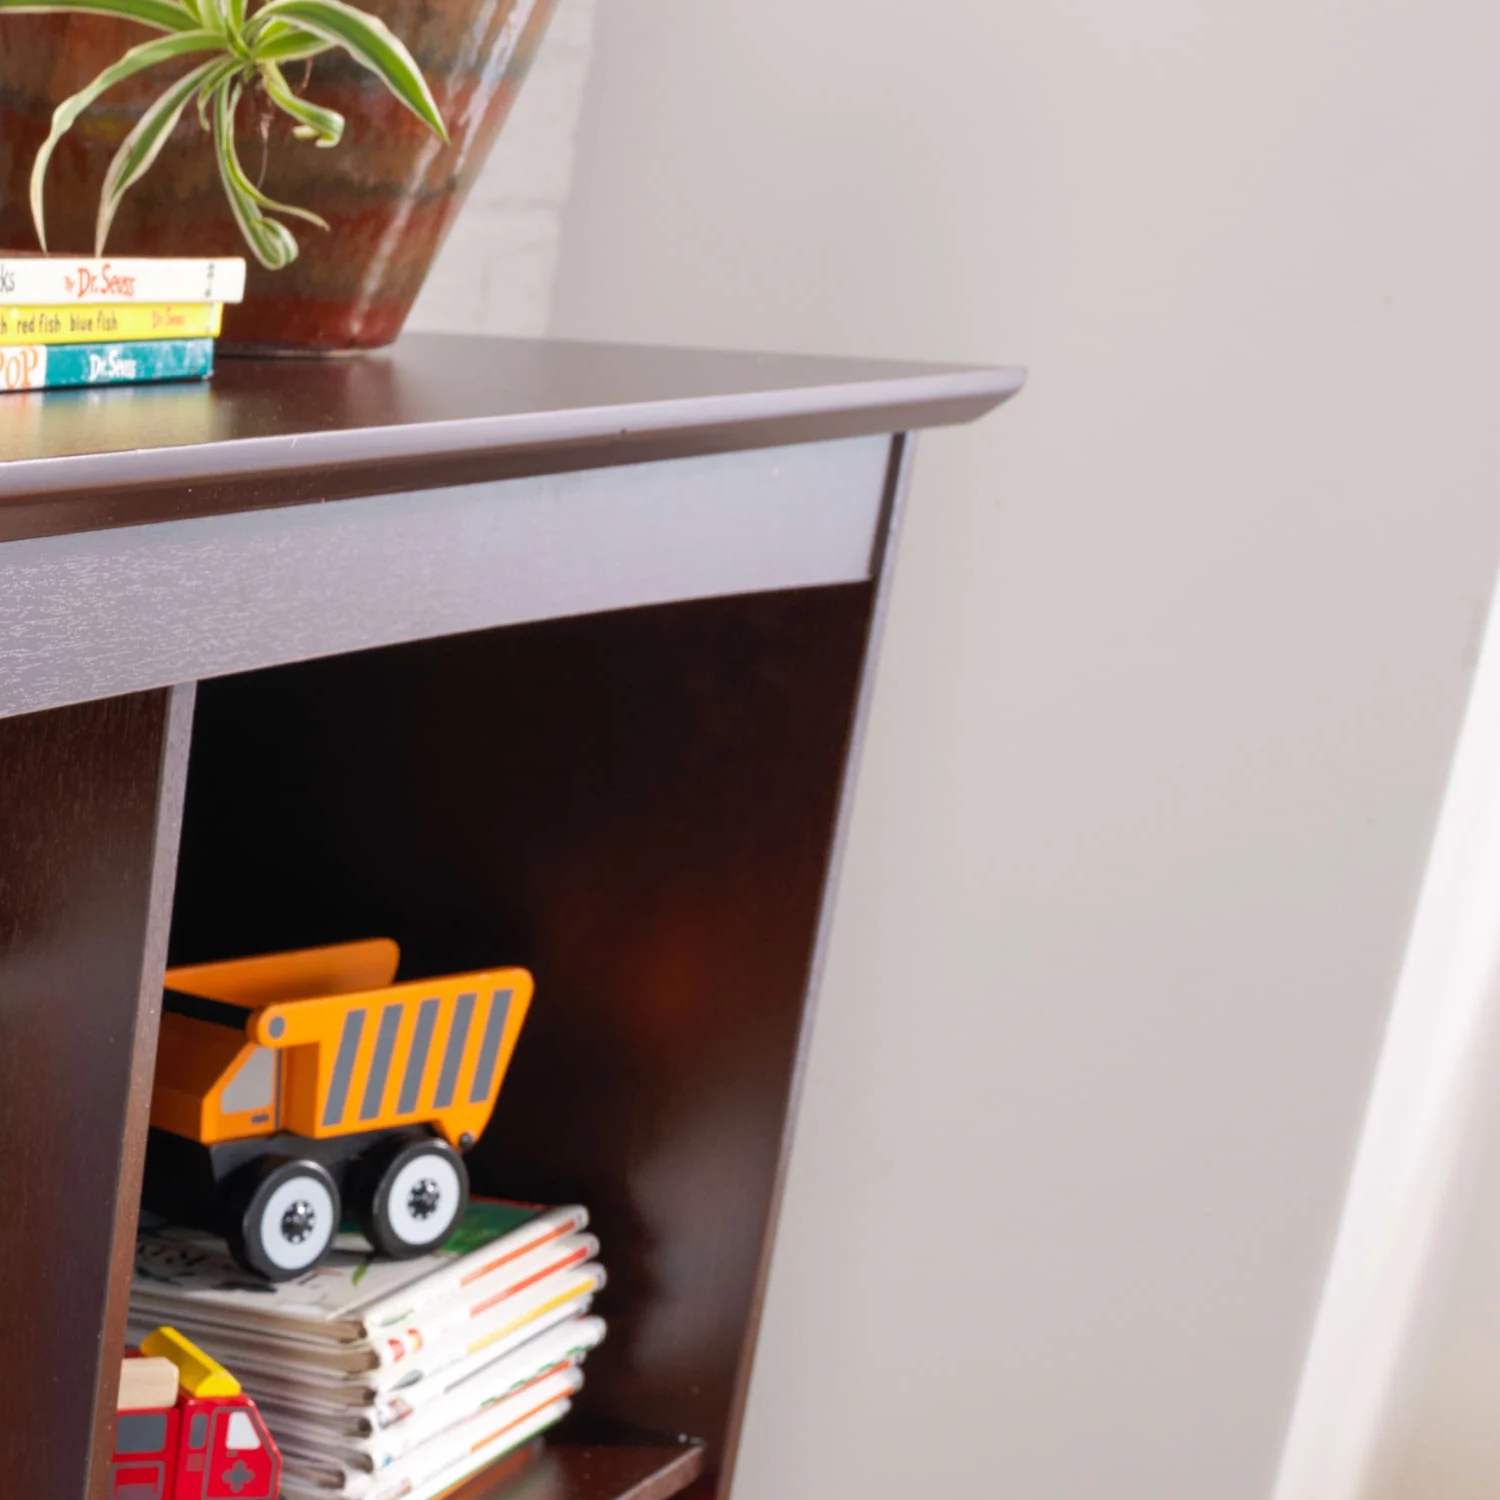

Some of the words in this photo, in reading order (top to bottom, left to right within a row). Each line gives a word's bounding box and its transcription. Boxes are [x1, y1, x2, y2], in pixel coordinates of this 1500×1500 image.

[77, 267, 99, 298] Dr.
[100, 263, 136, 297] Seuss
[16, 313, 35, 334] red
[39, 311, 61, 334] fish
[70, 311, 93, 332] blue
[97, 308, 118, 332] fish
